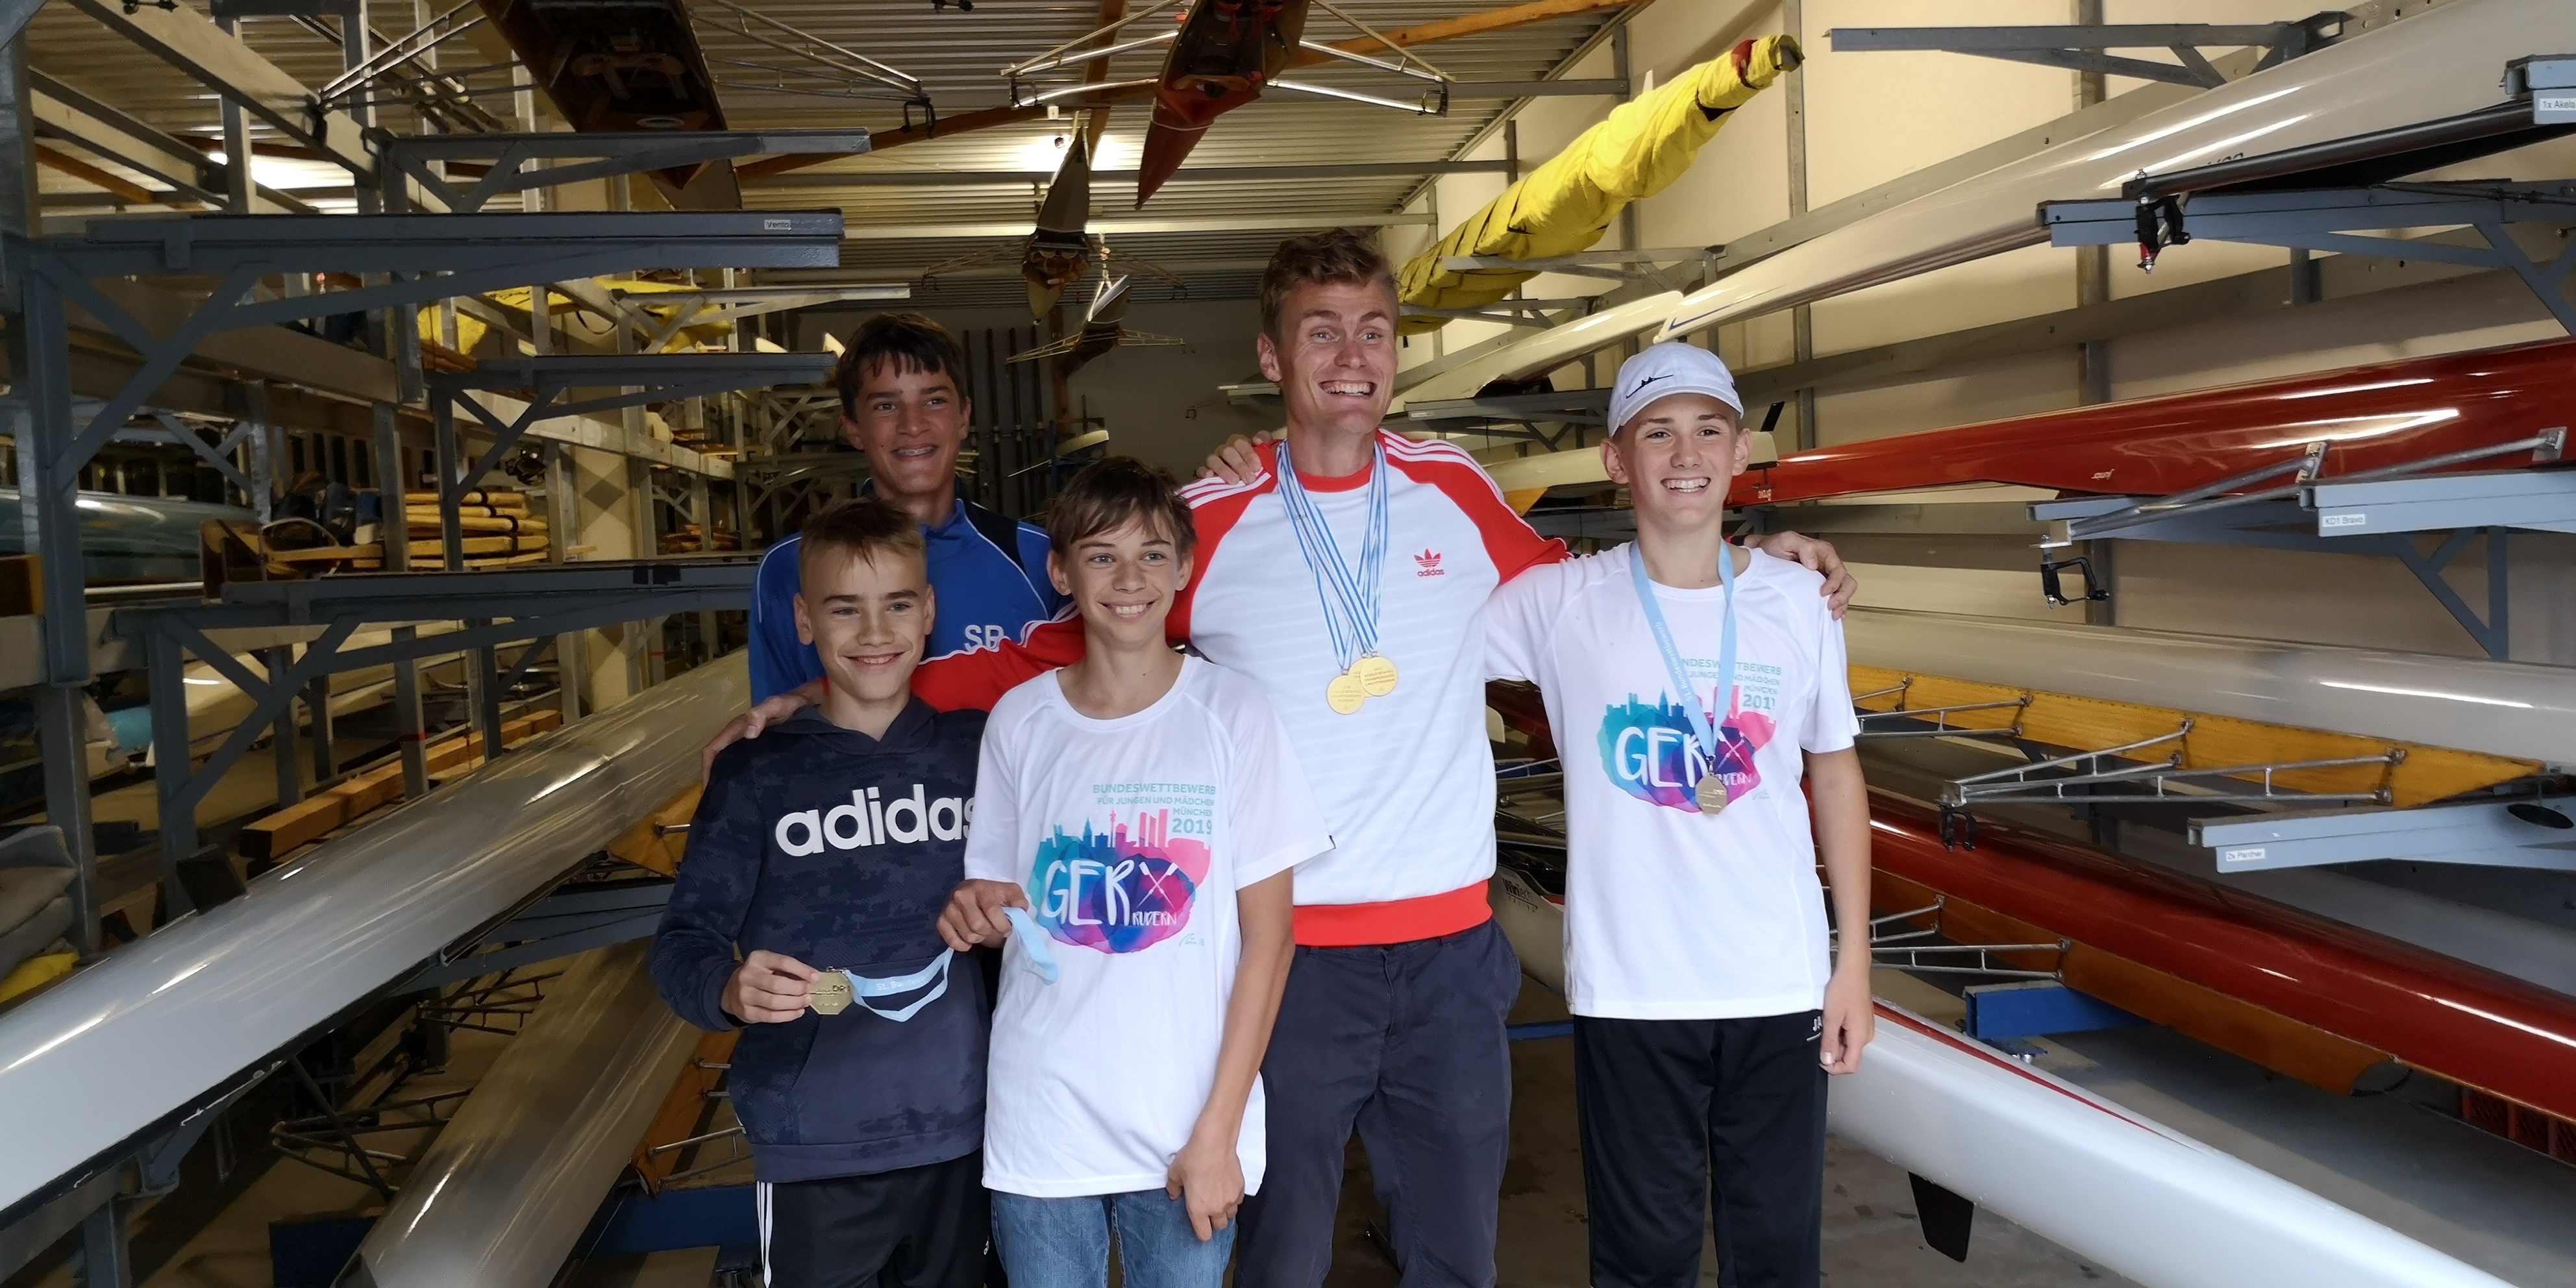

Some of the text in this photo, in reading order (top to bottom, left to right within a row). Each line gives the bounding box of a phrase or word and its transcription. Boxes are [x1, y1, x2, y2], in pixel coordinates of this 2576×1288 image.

[1093, 783, 1216, 795] BUNDESWETTBEWERB
[1116, 796, 1152, 805] JUNGEN
[1153, 796, 1172, 804] UND
[1174, 795, 1214, 806] MÄDCHEN
[1173, 806, 1213, 817] MÜNCHEN
[1172, 817, 1213, 835] 2019
[1041, 859, 1135, 926] GER
[1132, 910, 1178, 927] RUDERN
